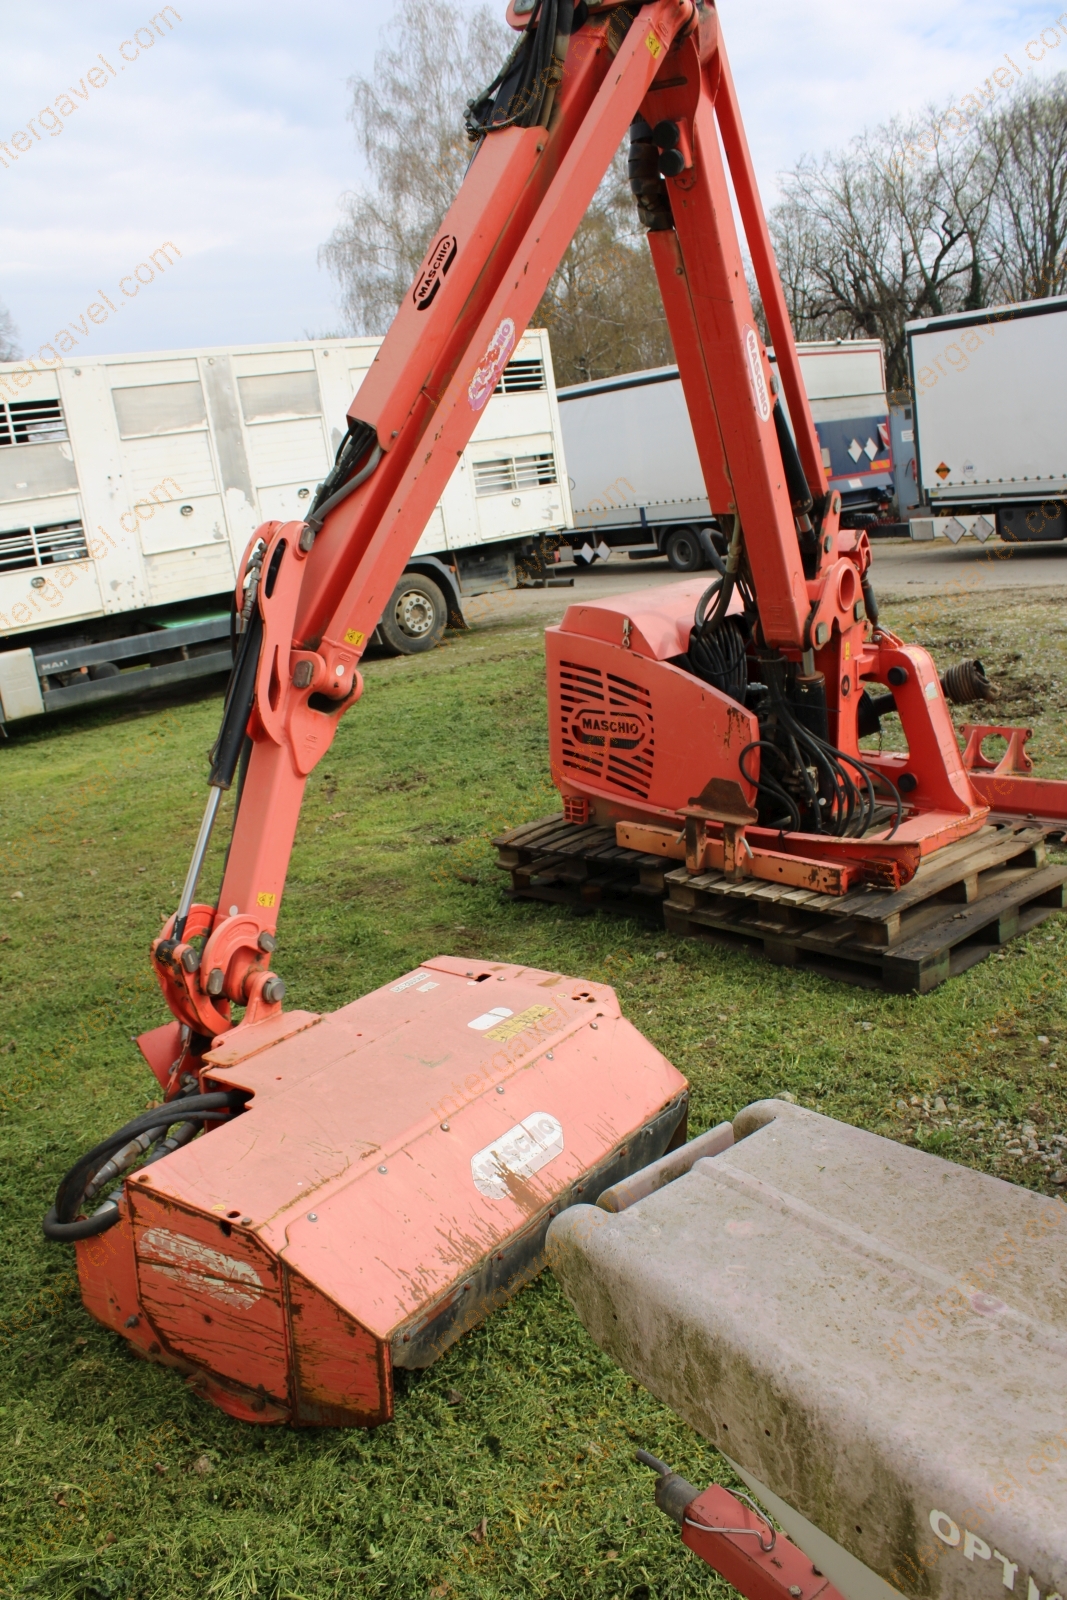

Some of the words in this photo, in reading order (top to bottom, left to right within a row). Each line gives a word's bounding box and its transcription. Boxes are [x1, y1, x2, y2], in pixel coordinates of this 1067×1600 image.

[418, 241, 451, 298] MASCHIO
[748, 335, 769, 416] MASCHIO
[582, 717, 639, 735] MASCHIO
[929, 1509, 1064, 1600] OPTI
